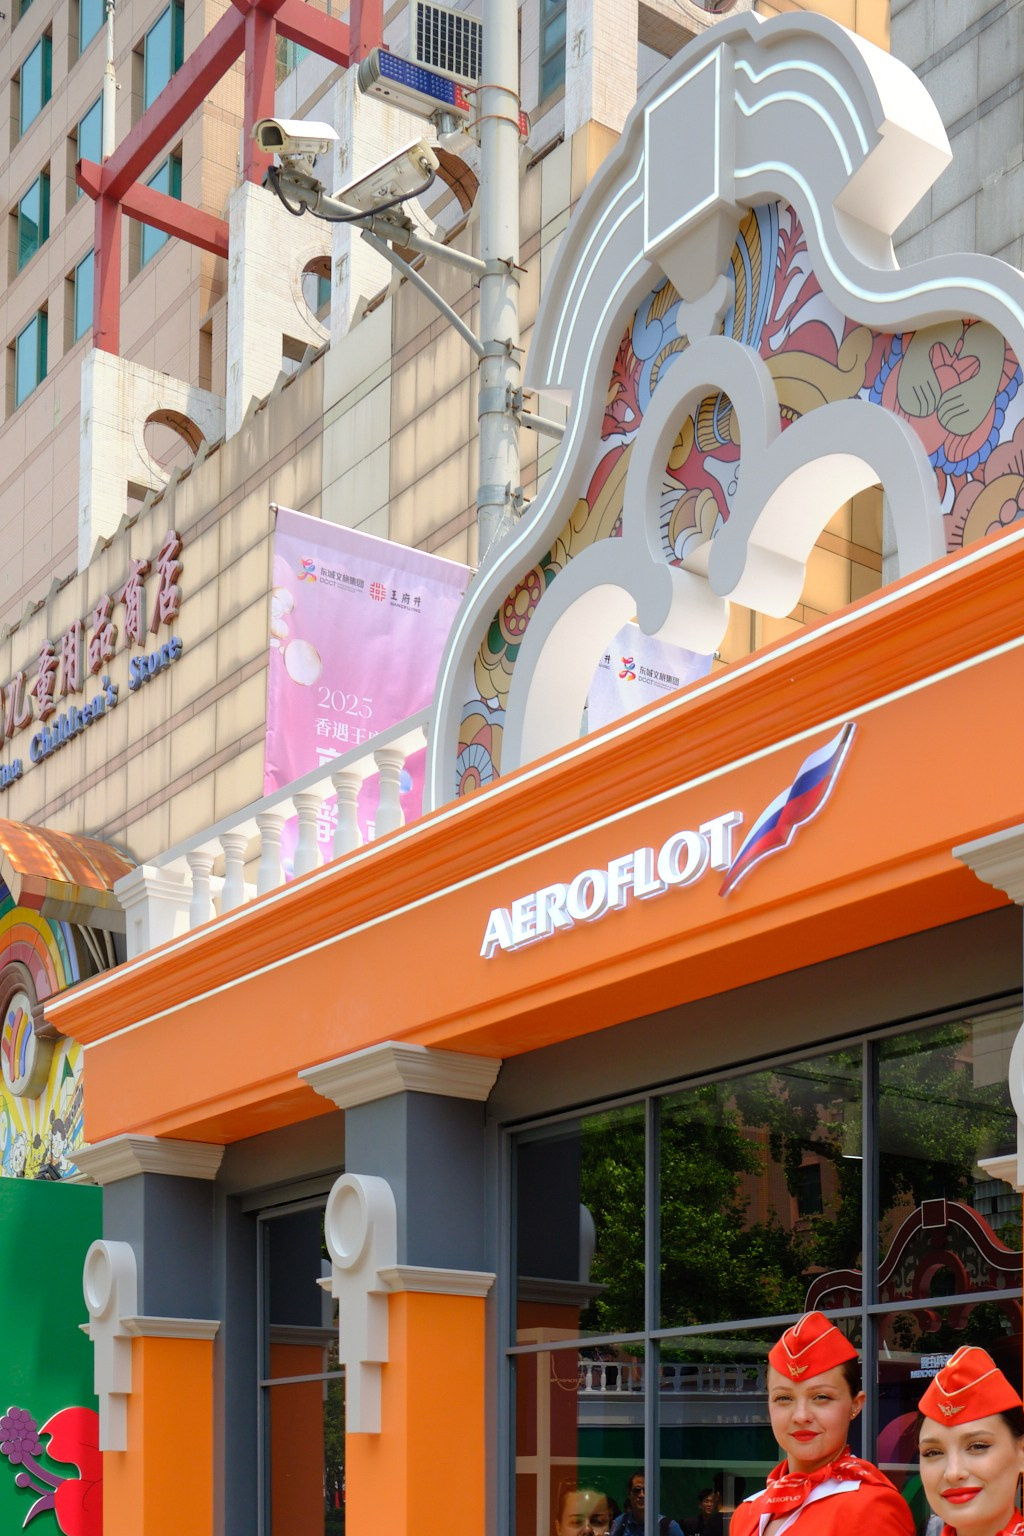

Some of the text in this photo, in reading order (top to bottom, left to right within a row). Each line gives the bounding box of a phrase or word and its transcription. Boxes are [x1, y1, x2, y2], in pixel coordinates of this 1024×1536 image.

[0, 529, 183, 749] 儿童用品商店
[390, 590, 421, 607] 王府井
[30, 675, 119, 764] Children's
[129, 635, 183, 691] Store
[317, 686, 373, 719] 2025
[480, 811, 744, 960] AEROFLOT
